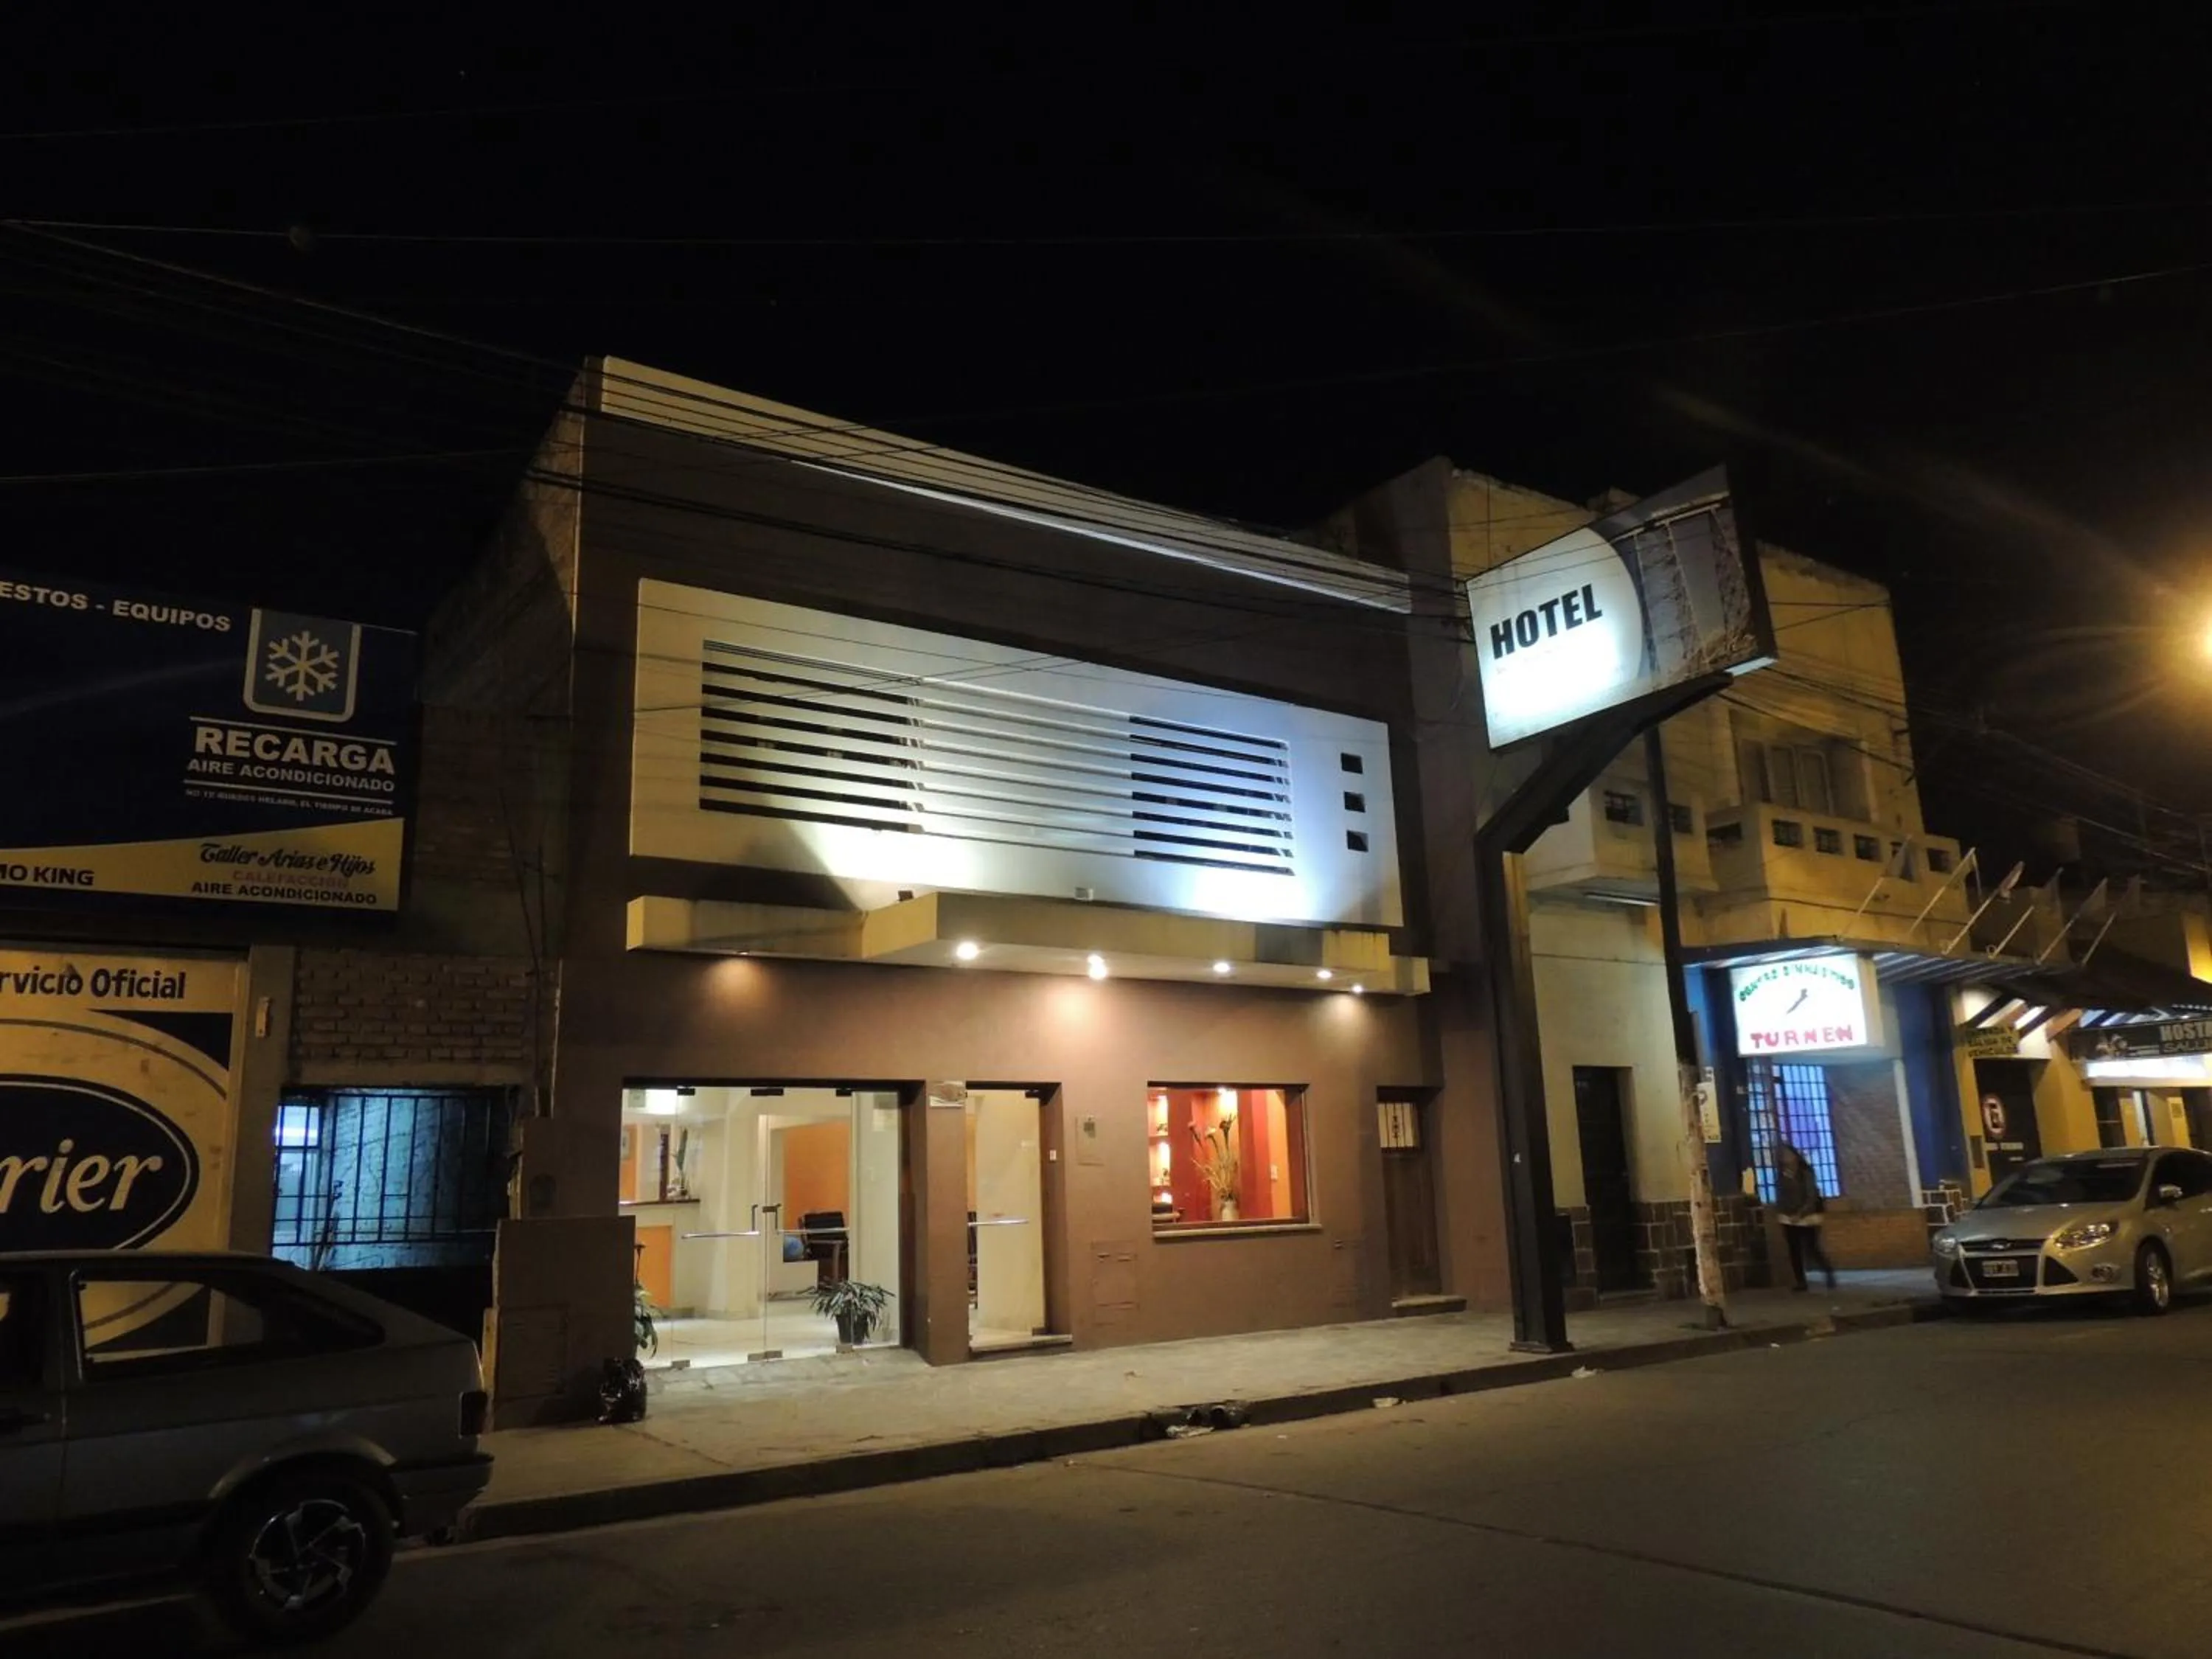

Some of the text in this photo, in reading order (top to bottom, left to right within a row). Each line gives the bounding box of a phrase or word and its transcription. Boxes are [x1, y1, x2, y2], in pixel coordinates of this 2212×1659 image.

[0, 580, 89, 610] ESTOS
[113, 600, 232, 632] EQUIPOS
[1489, 583, 1603, 660] HOTEL
[195, 726, 396, 776] RECARGA
[187, 758, 395, 792] AIRE ACONDICIONADO
[33, 866, 94, 886] KING
[200, 843, 259, 863] Taller
[258, 848, 315, 870] Arias
[328, 852, 376, 879] Hijos
[191, 882, 378, 905] AIRE ACONDICIONADO
[90, 967, 187, 999] Oficial
[1750, 1024, 1854, 1049] TURNEN
[0, 1138, 164, 1214] rier
